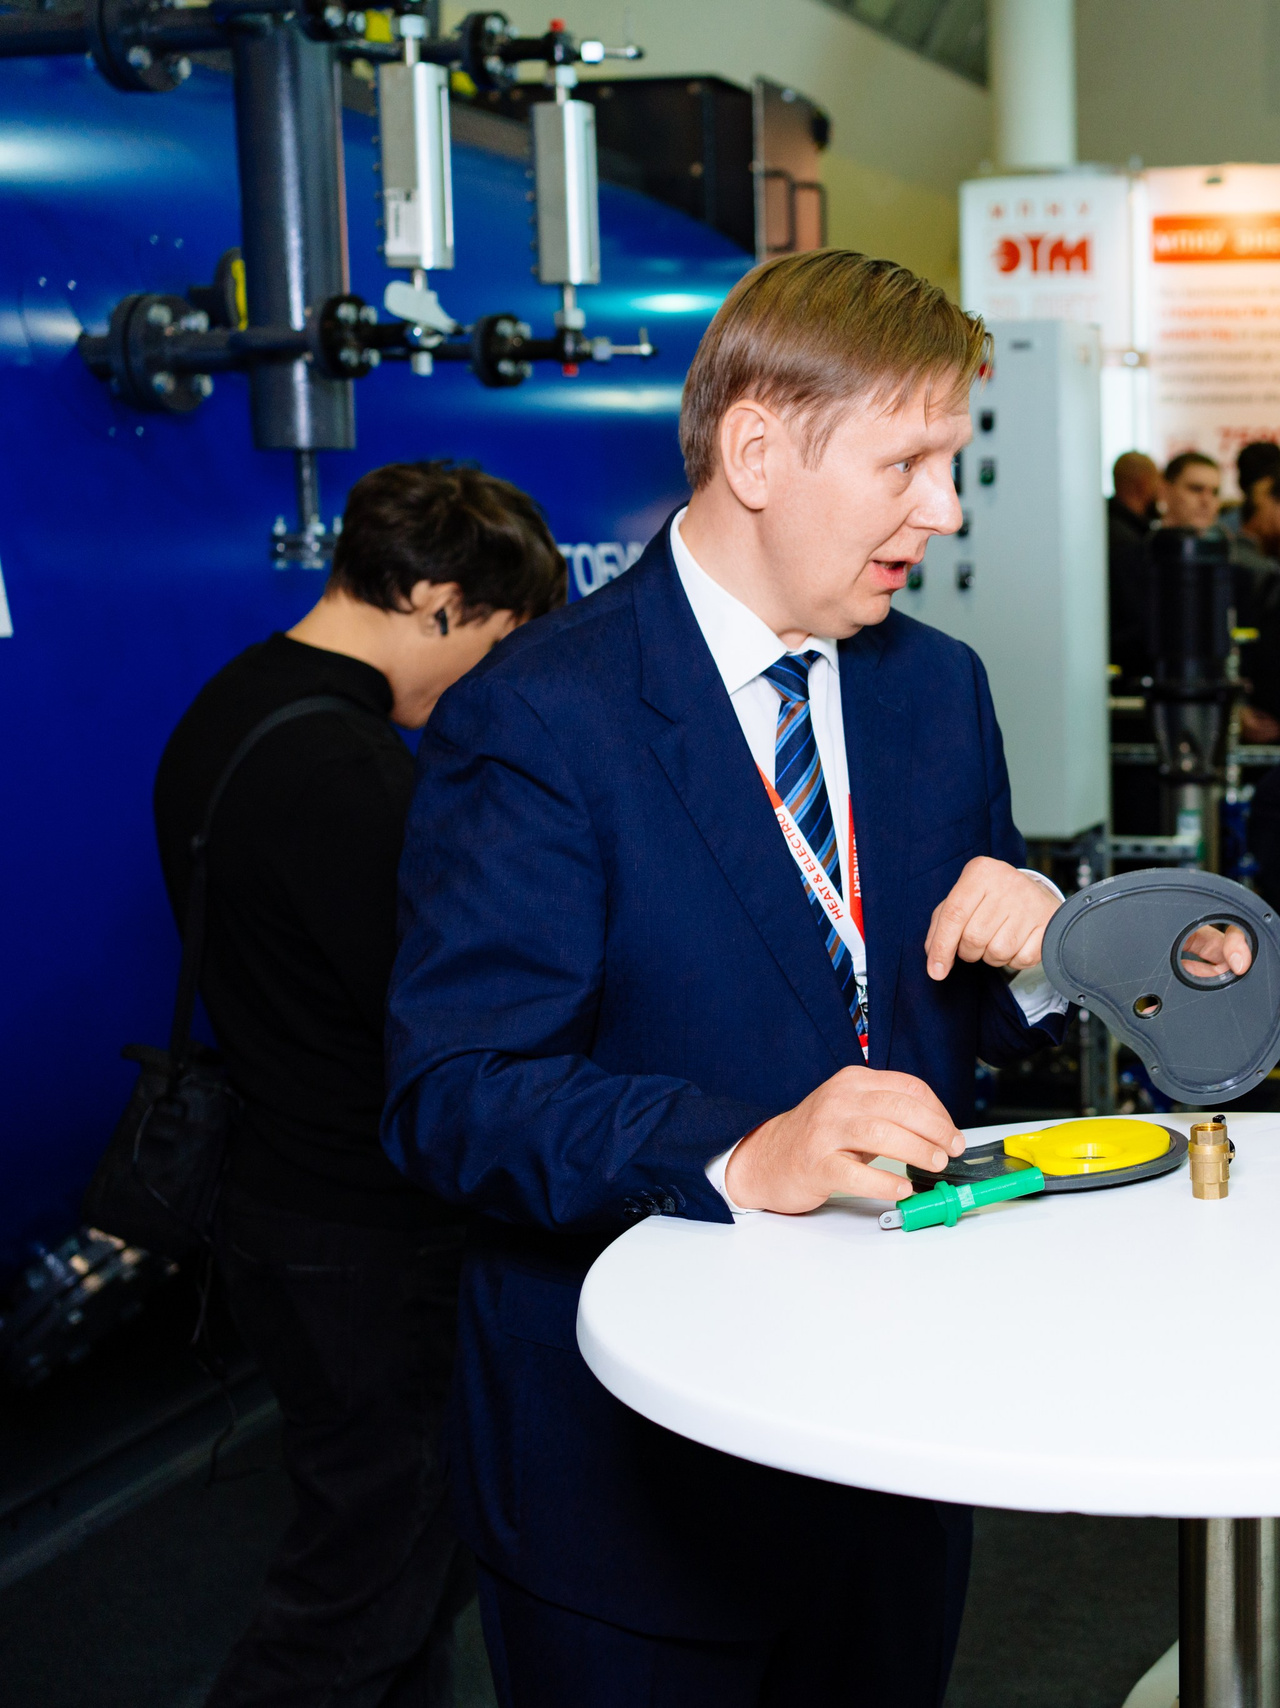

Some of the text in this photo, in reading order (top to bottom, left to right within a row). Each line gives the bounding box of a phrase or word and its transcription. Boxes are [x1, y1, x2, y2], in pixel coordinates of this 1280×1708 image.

[777, 813, 844, 920] HEAT & ELECTRO
